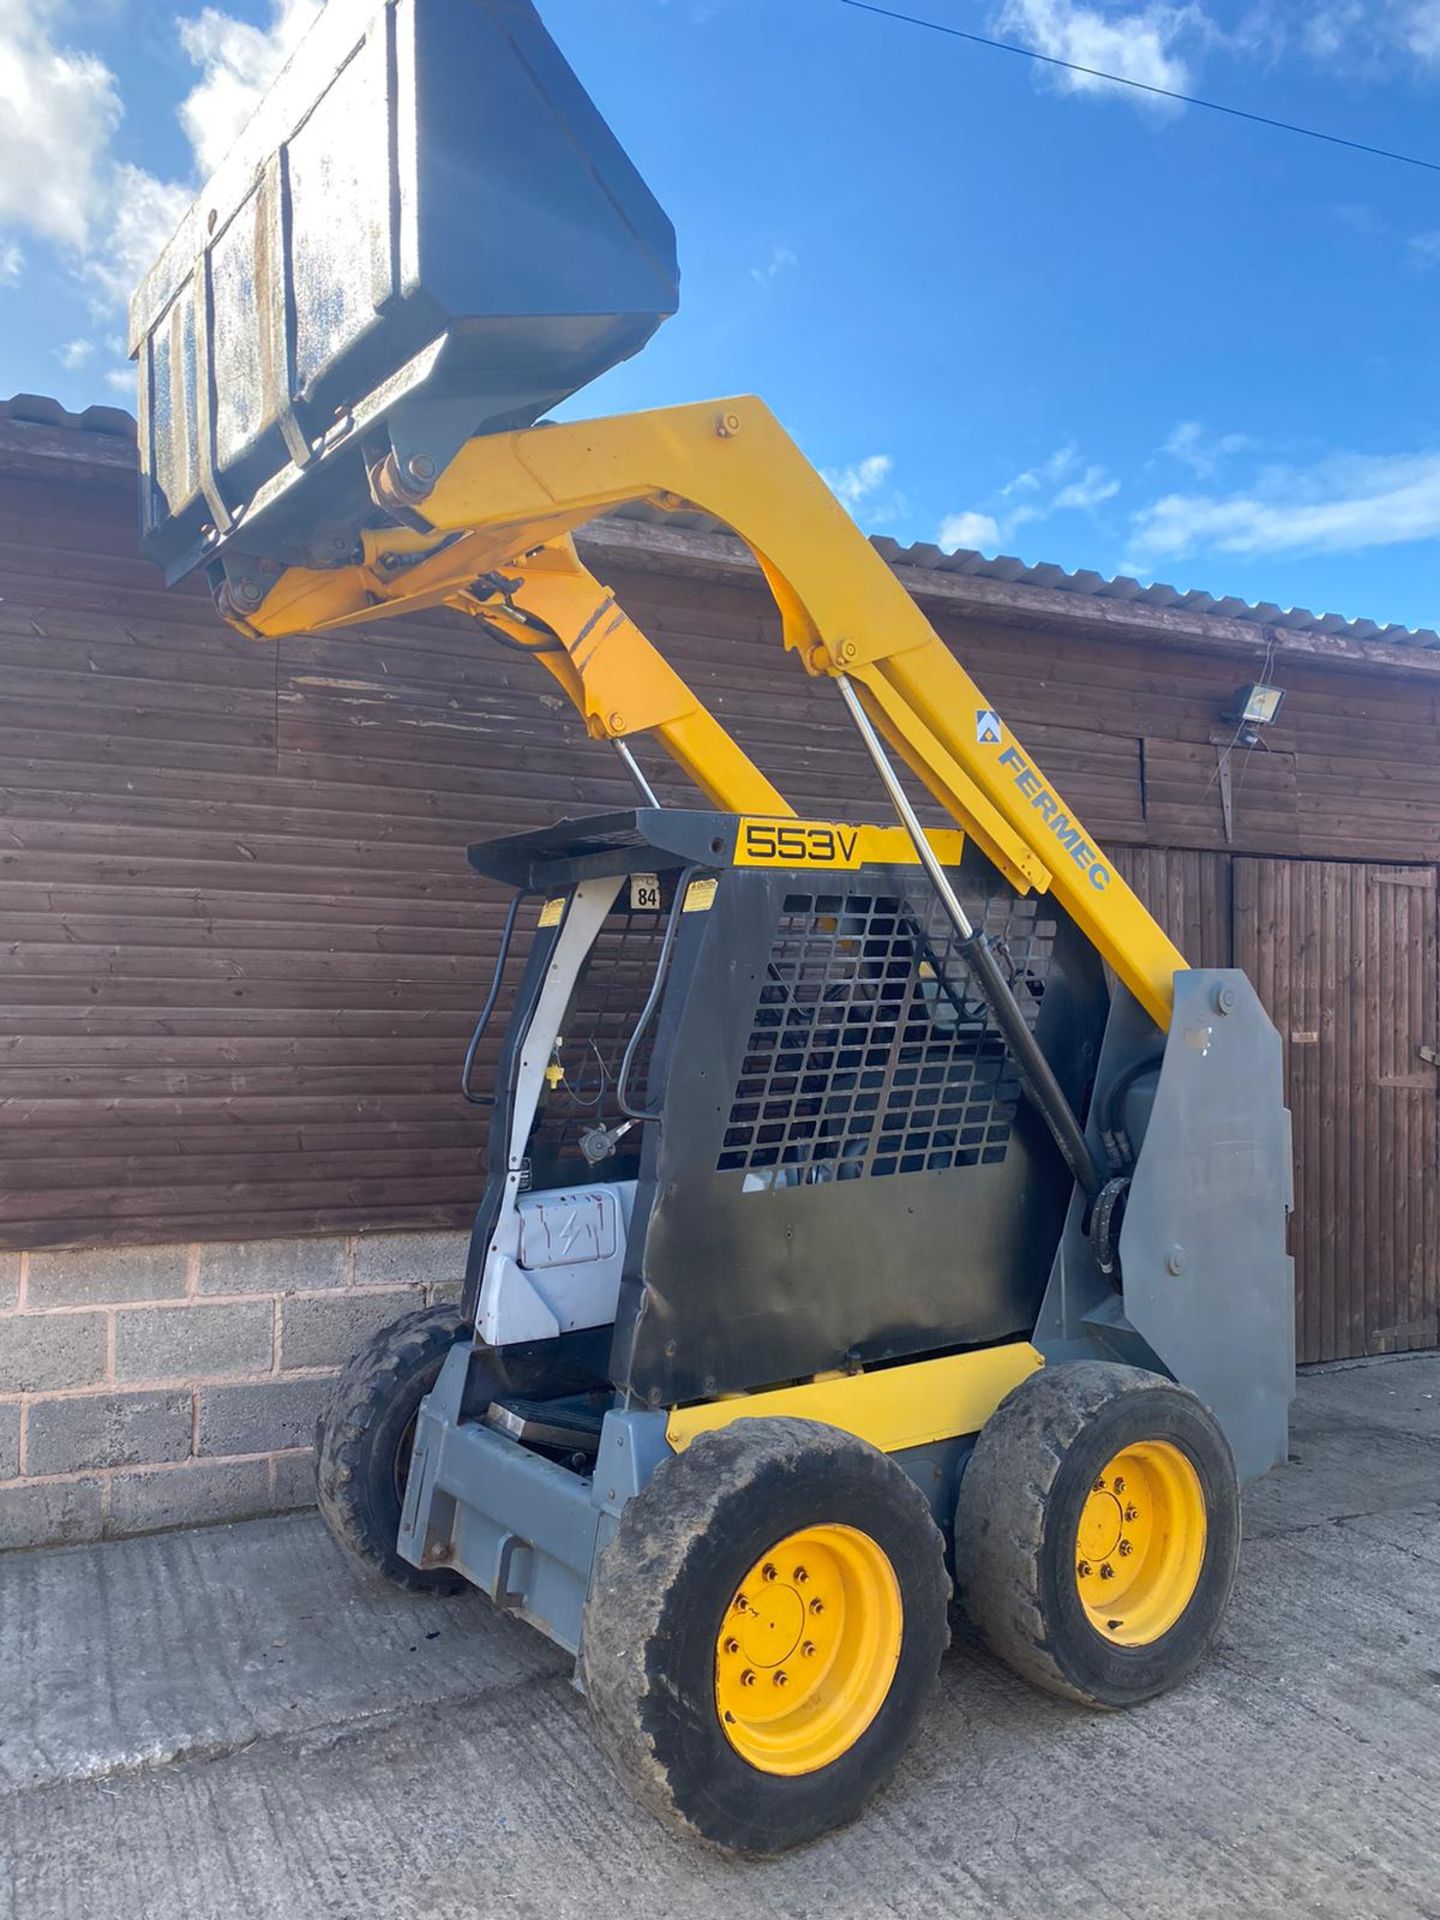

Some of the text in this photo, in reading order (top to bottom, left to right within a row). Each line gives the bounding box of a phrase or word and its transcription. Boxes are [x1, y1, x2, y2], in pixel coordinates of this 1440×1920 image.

[998, 746, 1110, 890] FERMEC
[746, 825, 858, 861] 553V
[638, 888, 657, 906] 84
